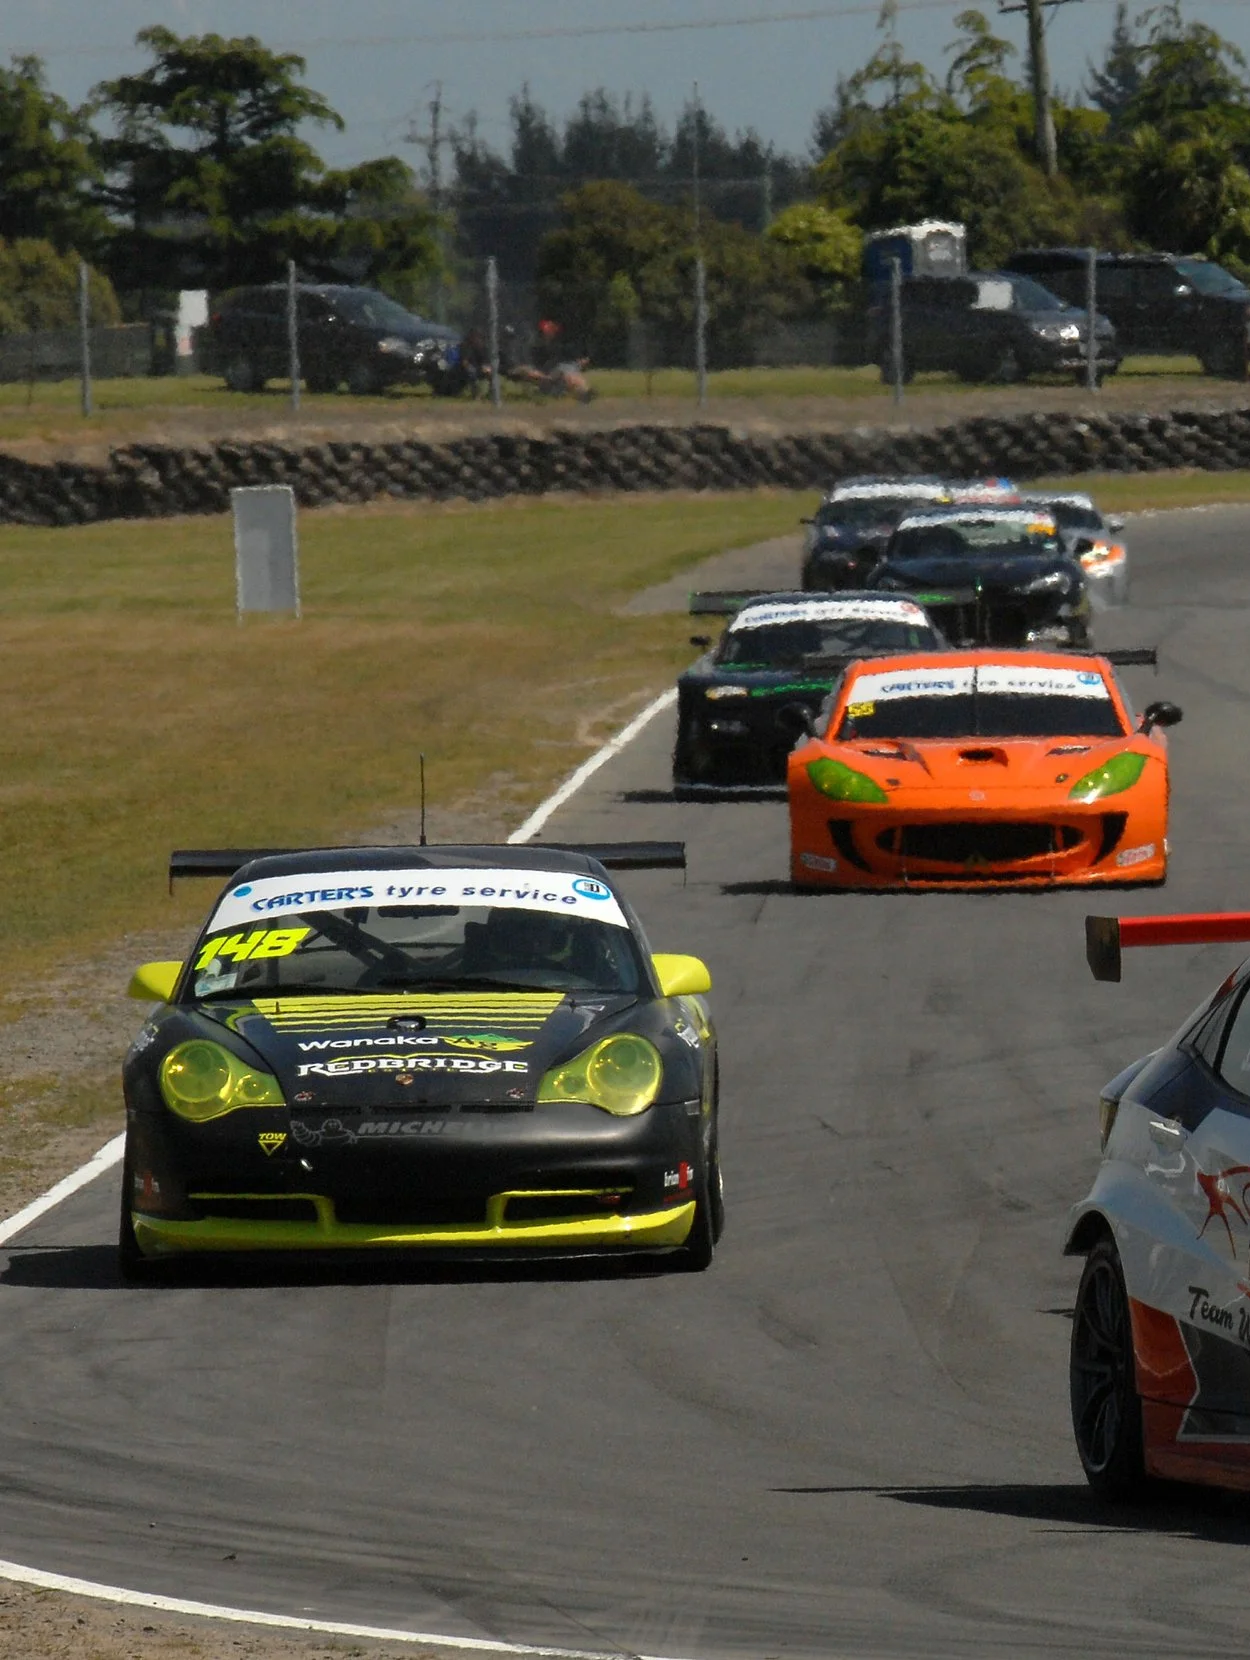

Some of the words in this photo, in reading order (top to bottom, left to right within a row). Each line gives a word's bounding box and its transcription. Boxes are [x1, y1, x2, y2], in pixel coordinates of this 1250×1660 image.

[252, 885, 374, 912] CARTER'S
[387, 885, 447, 898] tyre
[463, 884, 578, 905] service
[194, 927, 311, 970] 148
[298, 1036, 439, 1052] Wanaka
[297, 1058, 529, 1077] REDBRIDGE
[258, 1132, 287, 1140] TOW
[1188, 1285, 1235, 1331] Team
